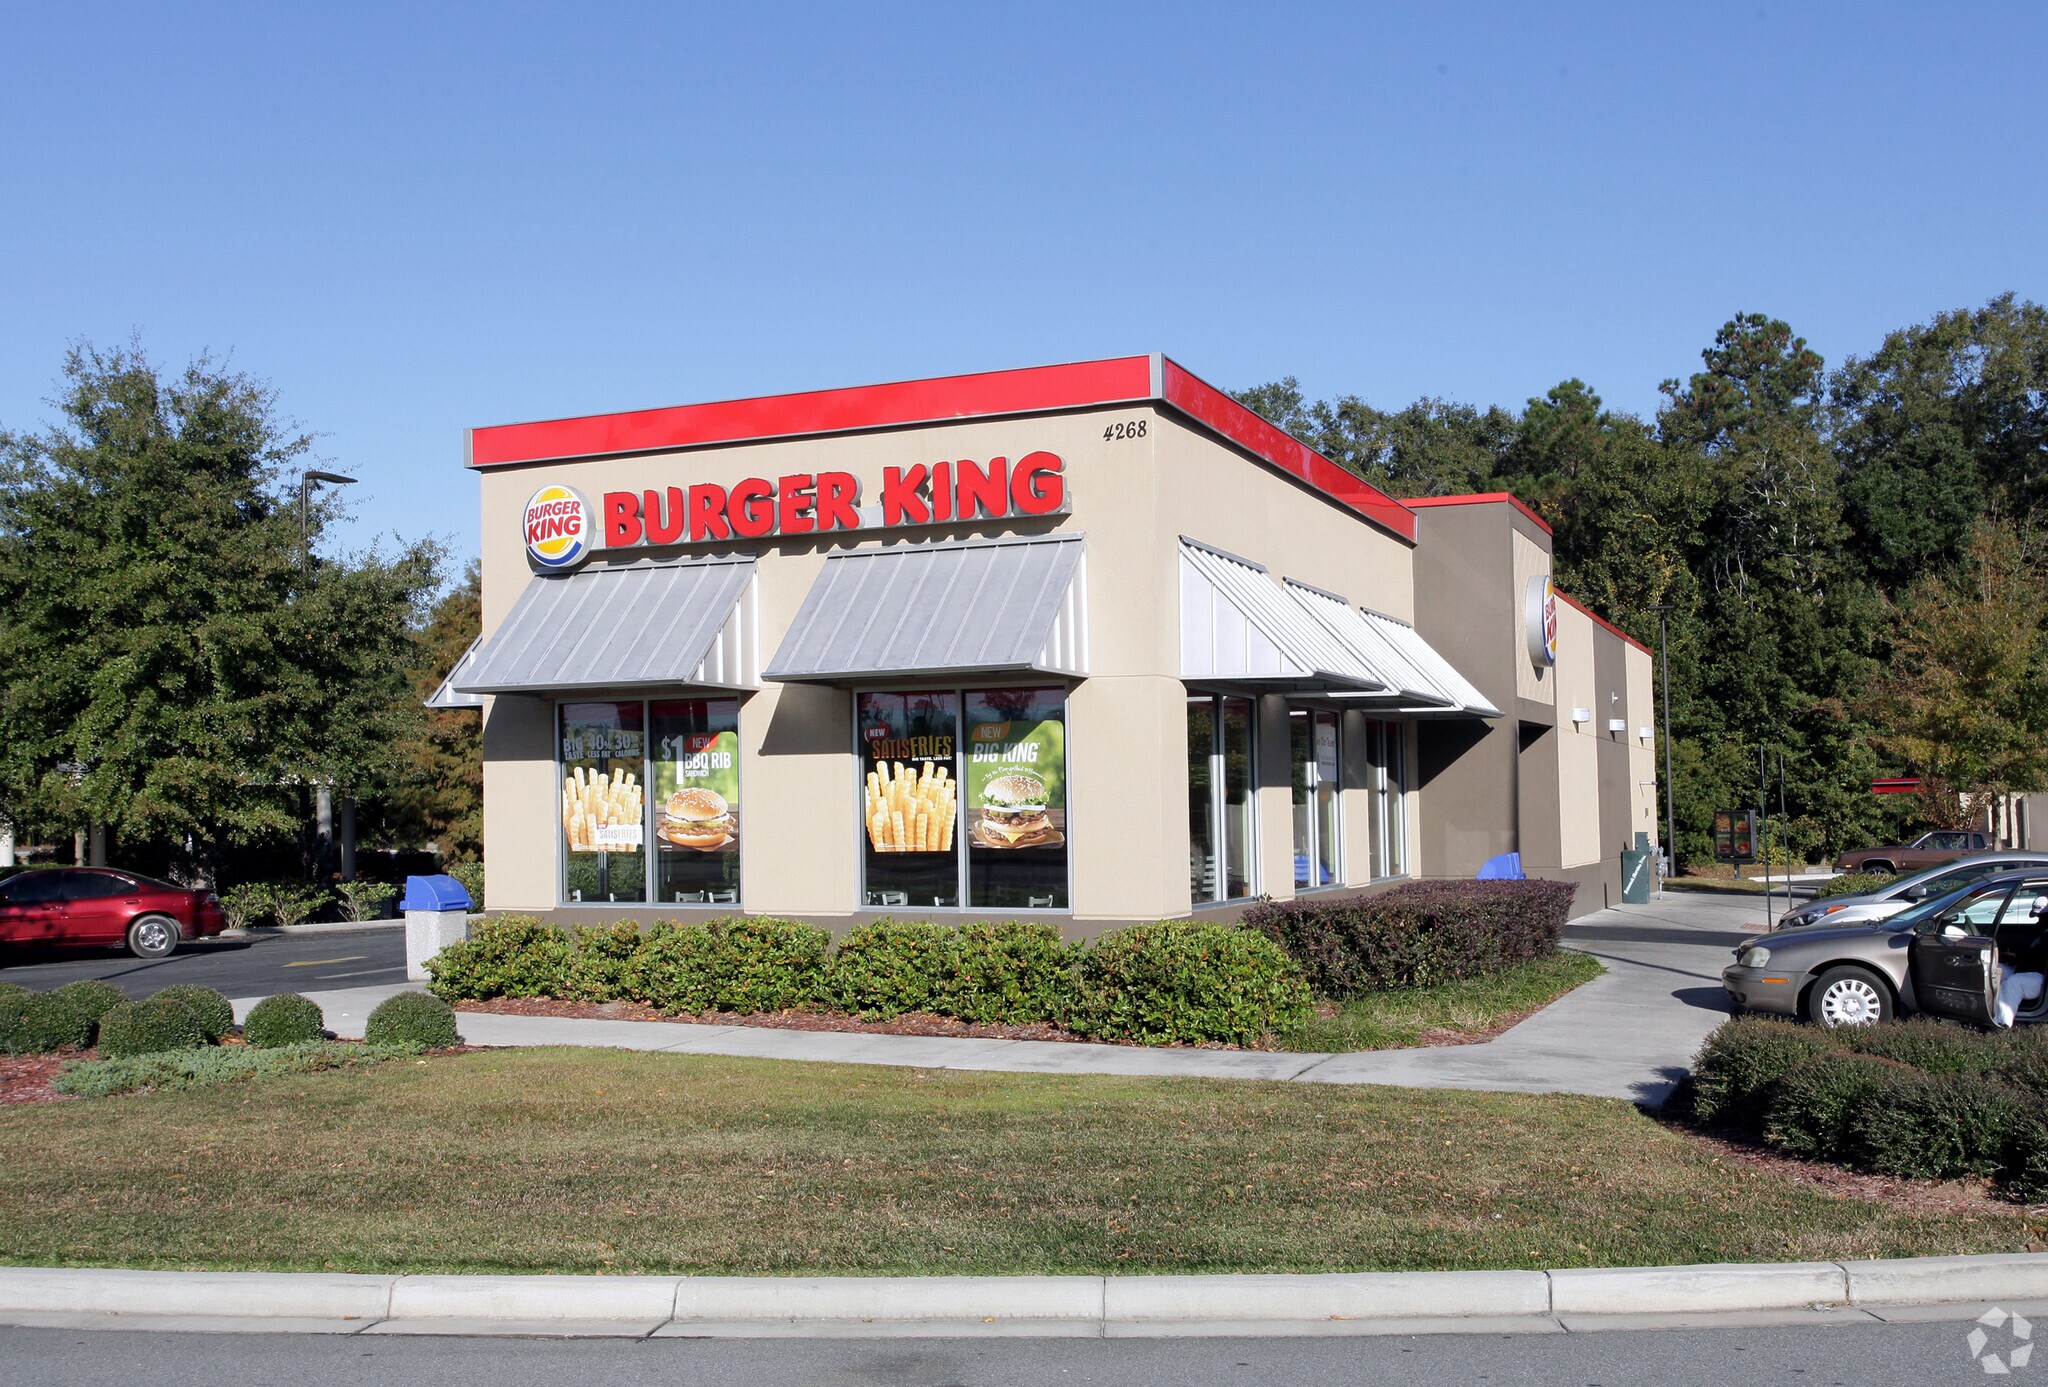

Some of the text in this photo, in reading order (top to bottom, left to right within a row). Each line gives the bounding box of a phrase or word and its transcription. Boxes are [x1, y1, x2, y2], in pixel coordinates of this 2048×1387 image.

[1103, 420, 1147, 441] 4268
[603, 450, 1066, 548] BURGER KING
[527, 501, 581, 524] BURGER
[528, 515, 581, 546] KING
[692, 737, 711, 749] NEW
[869, 728, 886, 737] NEW
[981, 726, 1002, 739] NEW
[564, 751, 585, 761] TASTE
[872, 735, 952, 759] SATISFRIES
[972, 742, 1039, 763] BIG KING
[661, 735, 684, 785] $1
[685, 752, 732, 770] BBQ RIB
[685, 770, 709, 778] SANDWICH
